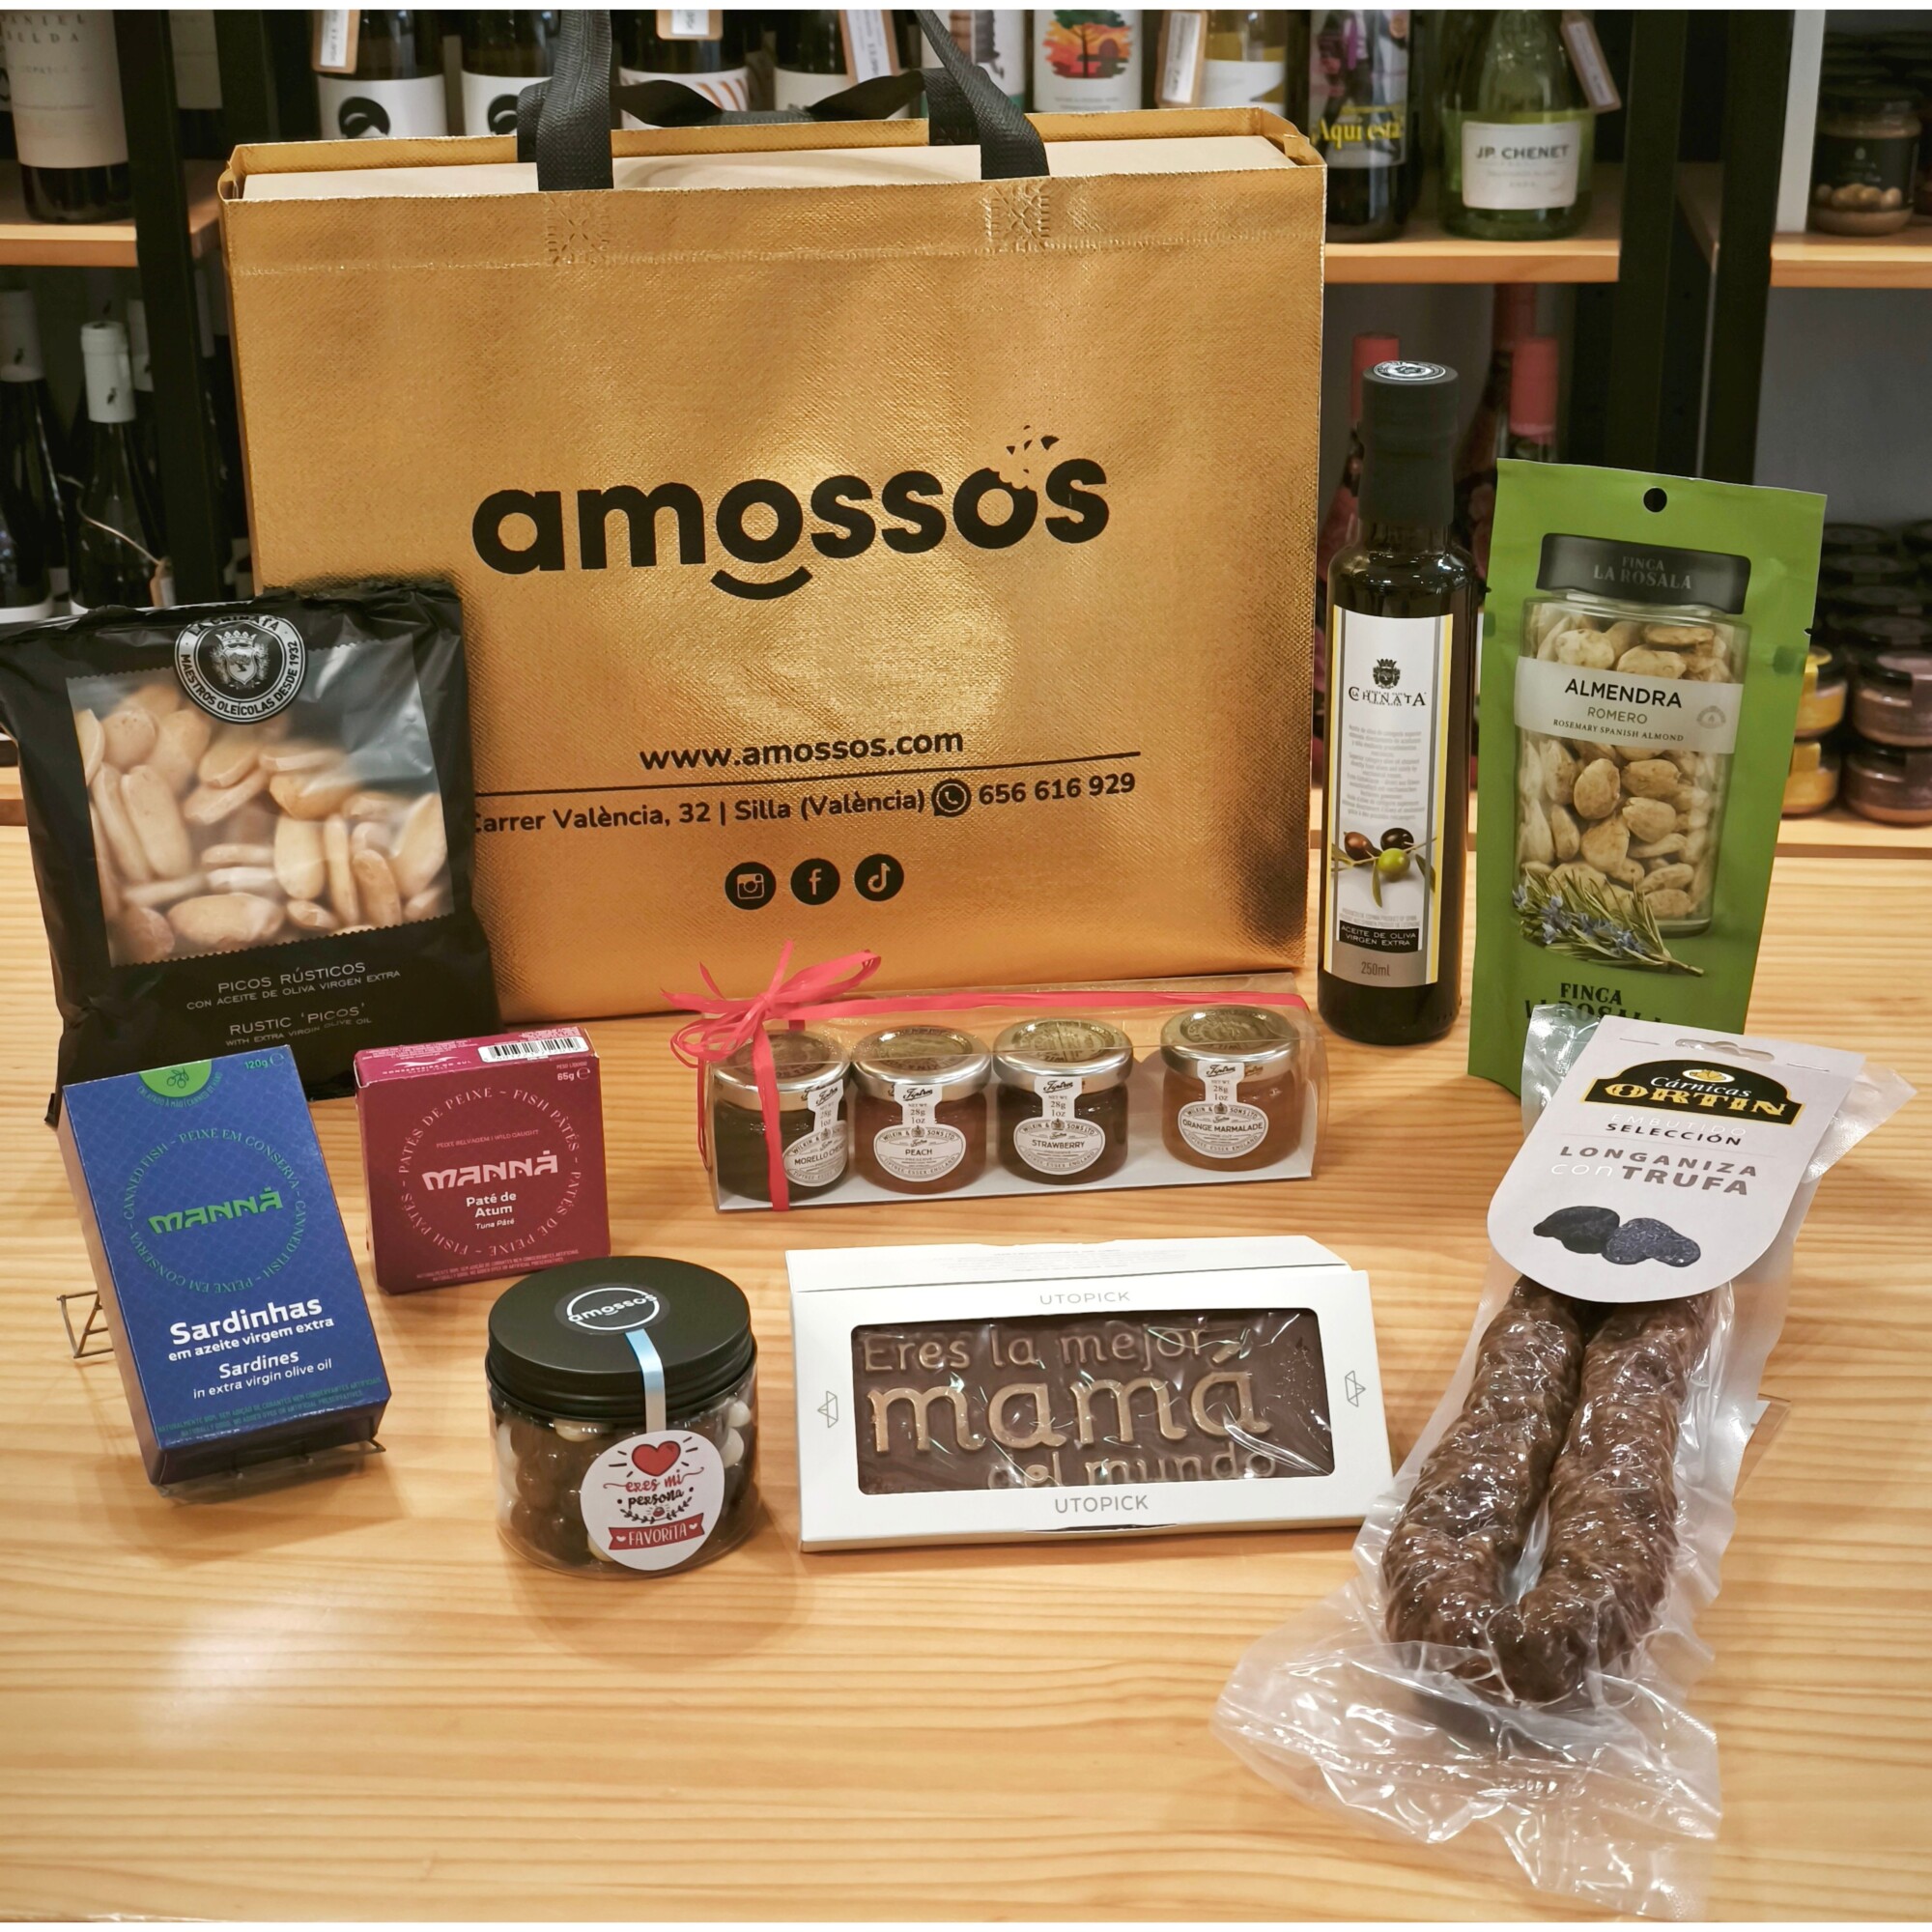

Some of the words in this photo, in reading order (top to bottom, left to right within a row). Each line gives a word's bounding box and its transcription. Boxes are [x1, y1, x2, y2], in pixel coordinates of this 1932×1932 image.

[1501, 143, 1570, 160] CHENET
[472, 454, 1109, 580] amossos
[1622, 555, 1665, 571] FINCA
[1594, 564, 1615, 581] LA
[1621, 568, 1691, 589] ROSALA
[181, 654, 216, 705] MAESTROS
[273, 668, 298, 702] DESDE
[287, 640, 299, 667] 1932
[1565, 678, 1682, 708] ALMENDRA
[1587, 706, 1648, 724] ROMERO
[1553, 719, 1599, 733] ROSEMARY
[1600, 725, 1639, 738] SPANISH
[1642, 731, 1685, 742] ALMOND
[639, 732, 963, 770] www.amossos.com
[979, 781, 1027, 806] 656
[1034, 777, 1082, 802] 616
[1089, 772, 1136, 797] 929
[554, 804, 671, 830] València,
[678, 801, 711, 823] 32
[734, 797, 791, 821] Silla
[801, 788, 924, 822] (València)
[1341, 925, 1369, 937] ACEITE
[1345, 933, 1378, 945] VIRGEN
[218, 977, 271, 993] PICOS
[280, 962, 366, 984] RÚSTICOS
[1360, 961, 1391, 977] 250ml
[186, 1000, 212, 1010] CON
[216, 992, 258, 1006] ACEITE
[262, 989, 278, 999] DE
[282, 984, 316, 996] OLIVA
[320, 977, 362, 990] VIRGEN
[367, 970, 401, 982] EXTRA
[1560, 982, 1622, 1006] FINCA
[225, 1037, 249, 1047] WITH
[253, 1032, 284, 1042] EXTRA
[289, 1026, 320, 1037] VIRGIN
[229, 1017, 292, 1036] RUSTIC
[244, 1060, 269, 1070] 120g
[556, 1071, 575, 1081] 65g
[1213, 1085, 1229, 1094] 28g
[1214, 1093, 1229, 1101] 1oz
[1650, 1077, 1752, 1097] Cárnicas
[421, 1108, 443, 1126] DE
[445, 1087, 493, 1110] PEIXE
[513, 1089, 550, 1111] FISH
[1050, 1100, 1066, 1109] 28g
[1605, 1083, 1788, 1116] ORTIN
[1066, 1122, 1084, 1131] SONS
[1182, 1119, 1212, 1132] ORANGE
[1213, 1122, 1264, 1133] MARMALADE
[1605, 1123, 1742, 1146] SELECCIÓN
[1610, 1114, 1747, 1136] EMBUTIDO
[1032, 1139, 1086, 1150] STRAWBERRY
[179, 1127, 217, 1144] PEIXE
[222, 1128, 242, 1142] EM
[244, 1136, 299, 1189] CONSERVA
[794, 1151, 829, 1166] MORELLO
[1560, 1146, 1758, 1177] LONGANIZA
[124, 1167, 145, 1220] CANNED
[140, 1143, 169, 1168] FISH
[1551, 1162, 1613, 1177] con
[1622, 1165, 1748, 1196] TRUFA
[466, 1193, 497, 1207] Paté
[500, 1191, 517, 1202] de
[474, 1206, 513, 1218] Atum
[286, 1201, 306, 1253] CANNED
[475, 1221, 495, 1230] Tuna
[537, 1217, 558, 1236] DE
[433, 1233, 469, 1255] FISH
[489, 1234, 535, 1256] PEIXE
[263, 1252, 291, 1278] FISH
[189, 1280, 210, 1293] EM
[213, 1277, 253, 1293] PEIXE
[568, 1293, 658, 1322] amossos
[1039, 1291, 1131, 1305] UTOPICK
[169, 1298, 323, 1345] Sardinhas
[168, 1349, 192, 1362] em
[195, 1338, 240, 1356] azeite
[242, 1326, 293, 1346] virgem
[296, 1318, 334, 1333] extra
[862, 1334, 972, 1372] Eres
[991, 1323, 1039, 1370] la
[1059, 1324, 1208, 1372] mejor
[218, 1351, 299, 1379] Sardines
[193, 1388, 205, 1400] in
[209, 1380, 242, 1396] extra
[245, 1372, 282, 1389] virgin
[285, 1362, 315, 1378] olive
[317, 1358, 332, 1371] oil
[867, 1342, 1271, 1452] mamá
[625, 1478, 661, 1492] eres
[664, 1469, 683, 1488] mi
[628, 1489, 684, 1510] persona
[1054, 1493, 1150, 1515] UTOPICK
